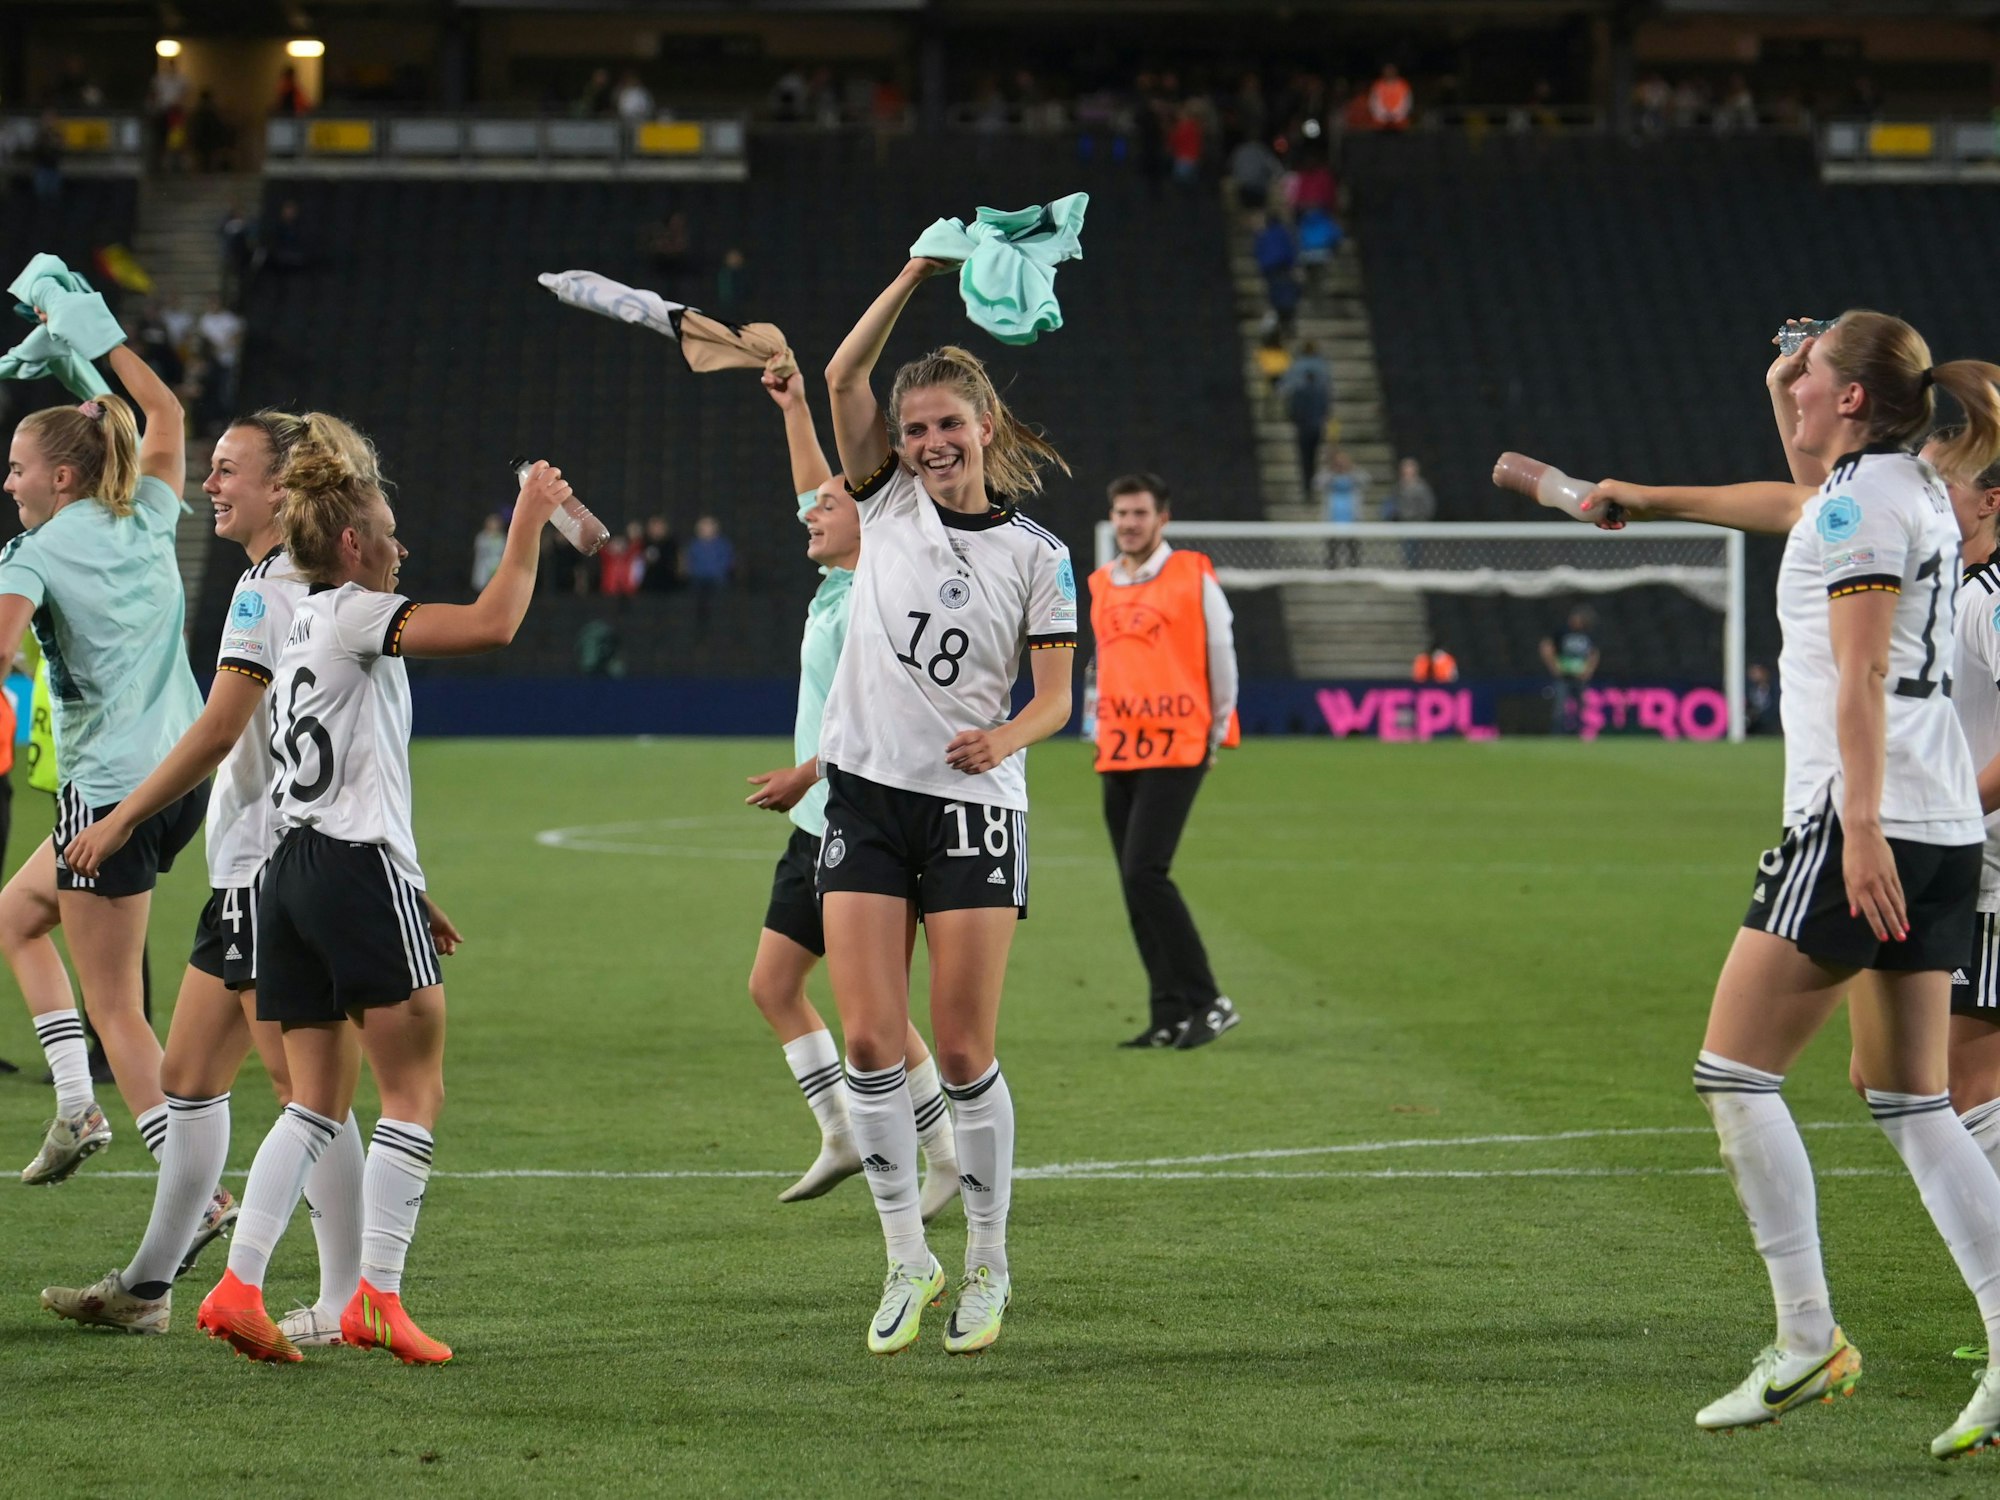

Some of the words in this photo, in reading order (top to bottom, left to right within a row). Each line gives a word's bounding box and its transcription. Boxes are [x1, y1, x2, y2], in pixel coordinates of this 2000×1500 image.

[897, 610, 970, 687] 18
[1894, 541, 1961, 699] 1
[269, 666, 334, 809] 16
[1095, 728, 1176, 762] 267
[944, 802, 1009, 858] 18
[987, 877, 1006, 885] adidas
